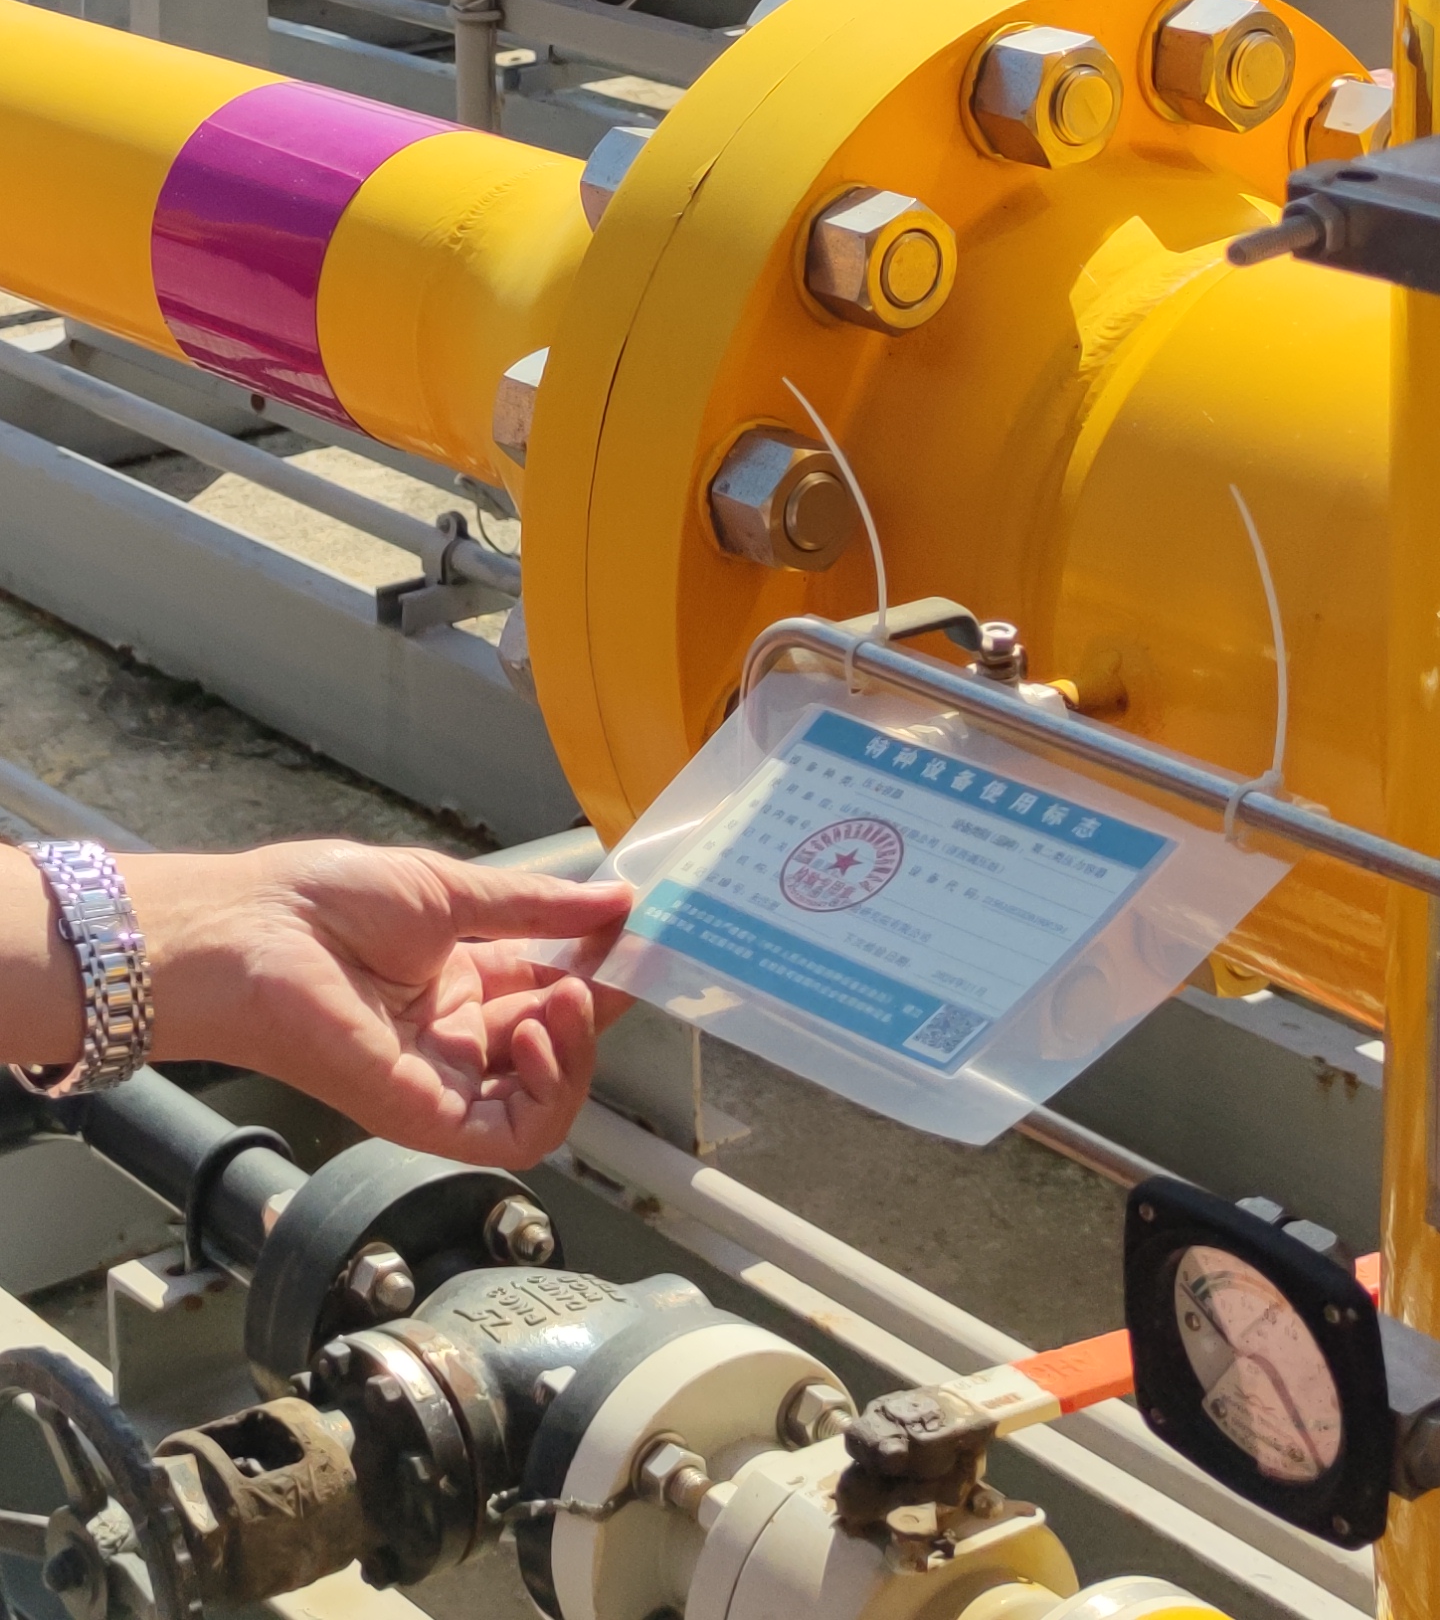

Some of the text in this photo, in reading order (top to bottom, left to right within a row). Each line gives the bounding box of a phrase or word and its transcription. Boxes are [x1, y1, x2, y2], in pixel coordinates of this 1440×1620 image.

[864, 736, 1103, 840] 特种设备使用标志
